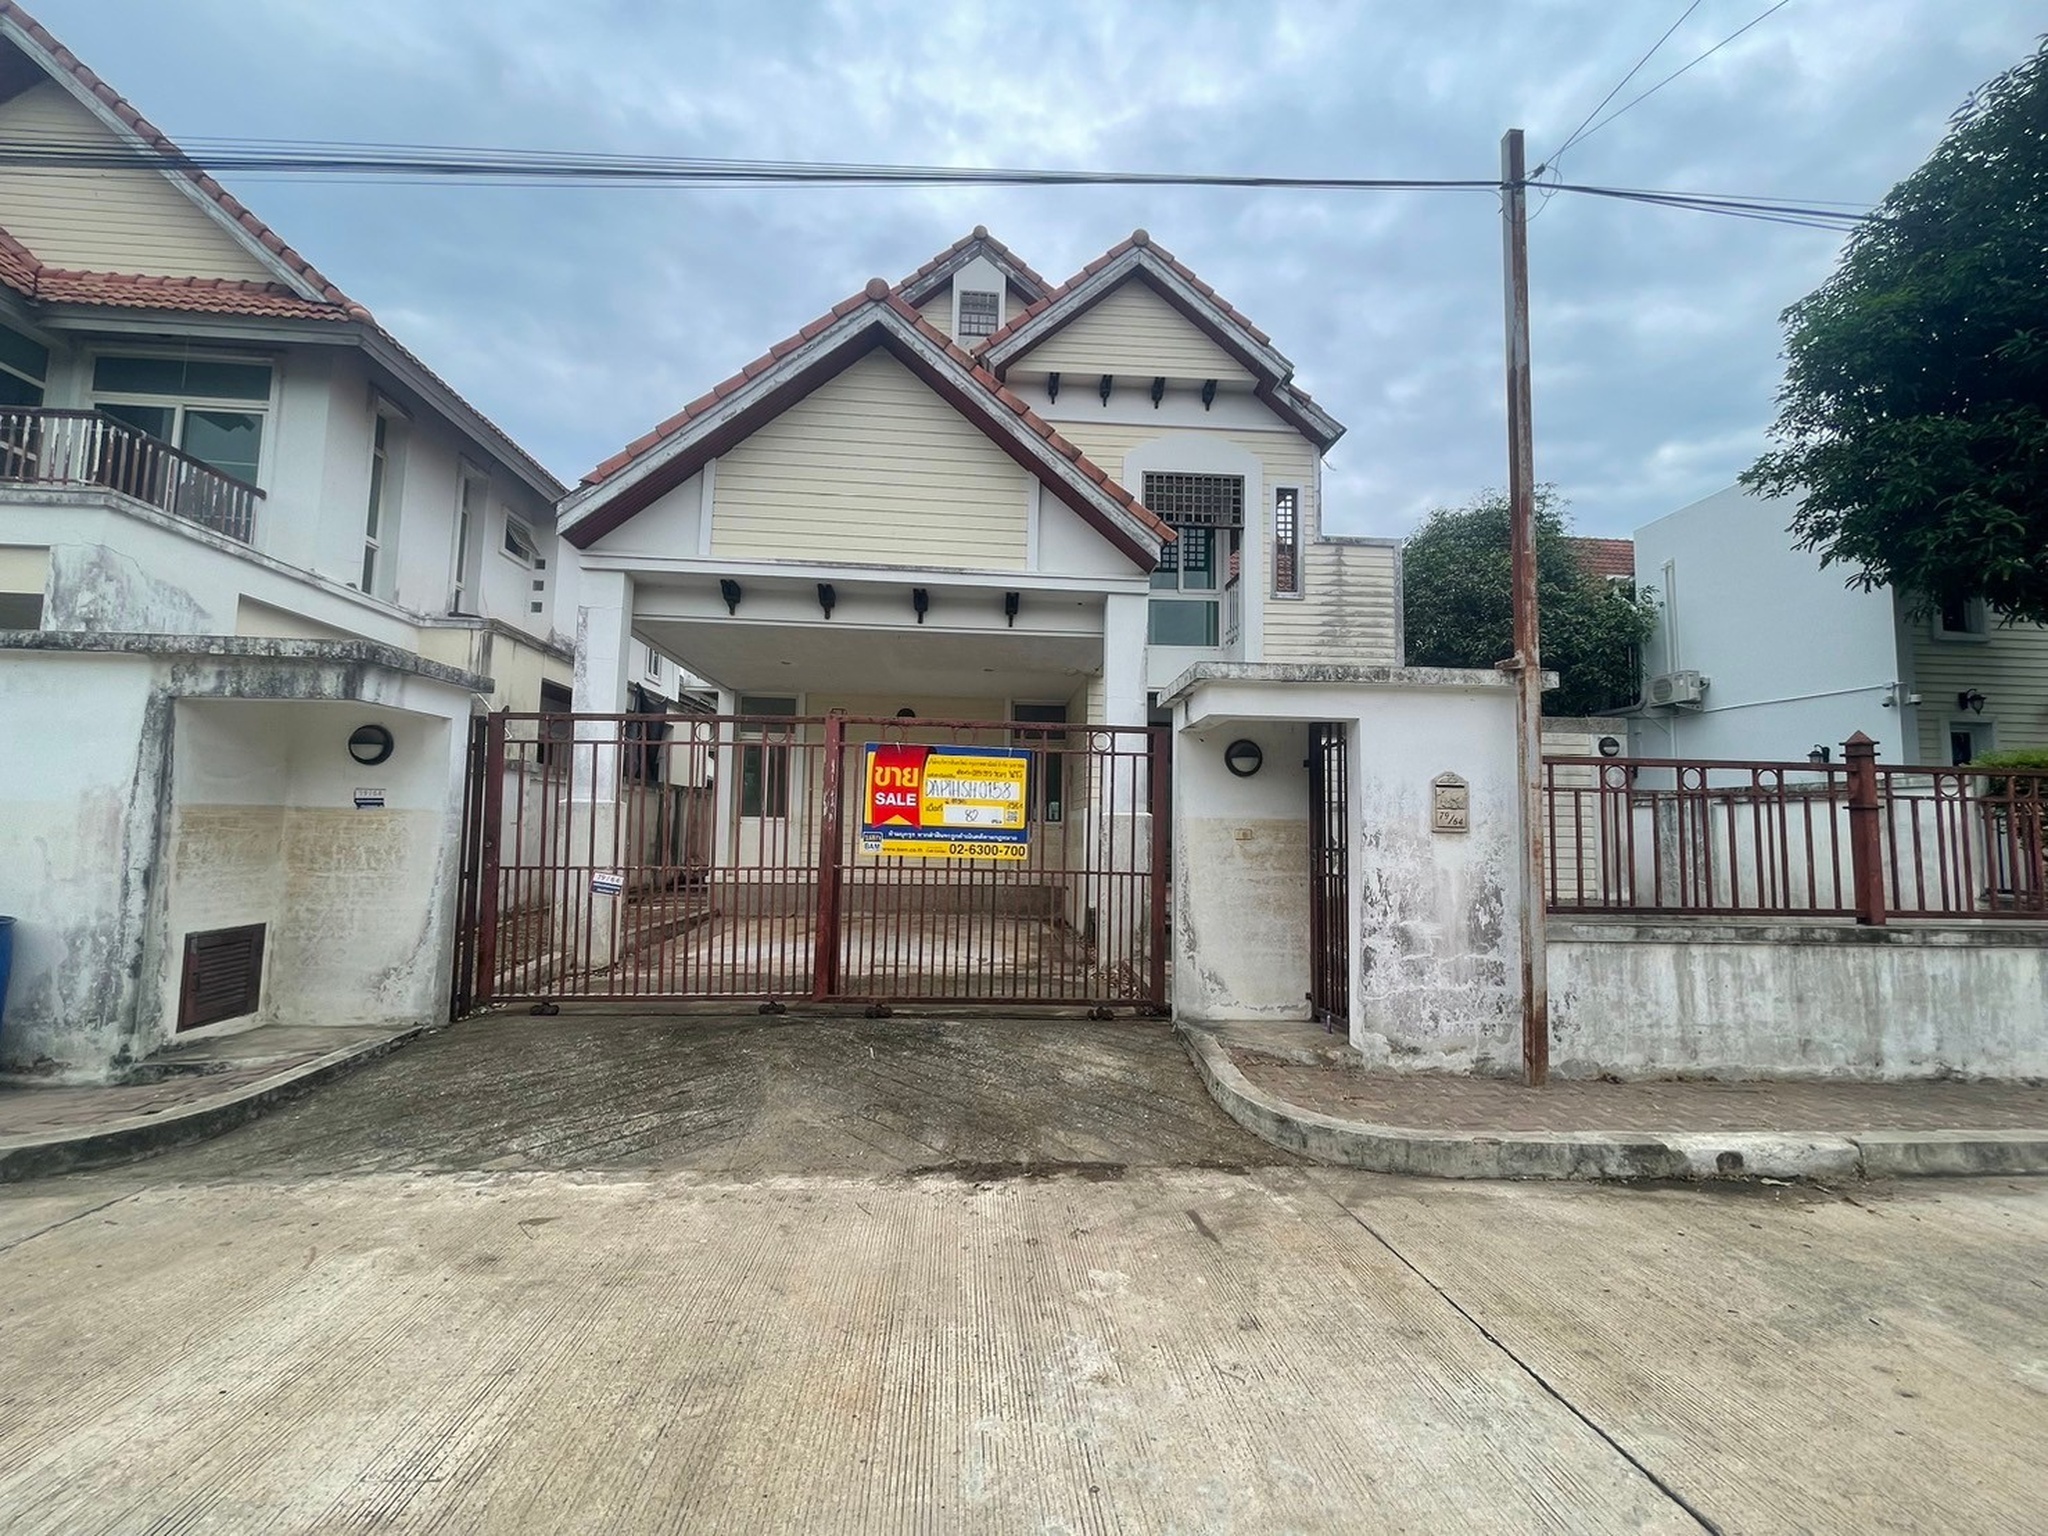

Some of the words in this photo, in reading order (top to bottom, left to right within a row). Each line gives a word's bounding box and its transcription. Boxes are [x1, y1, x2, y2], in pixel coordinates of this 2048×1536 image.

[875, 766, 920, 788] ขาย
[875, 792, 917, 806] SALE
[949, 843, 1026, 857] 02-6300-700
